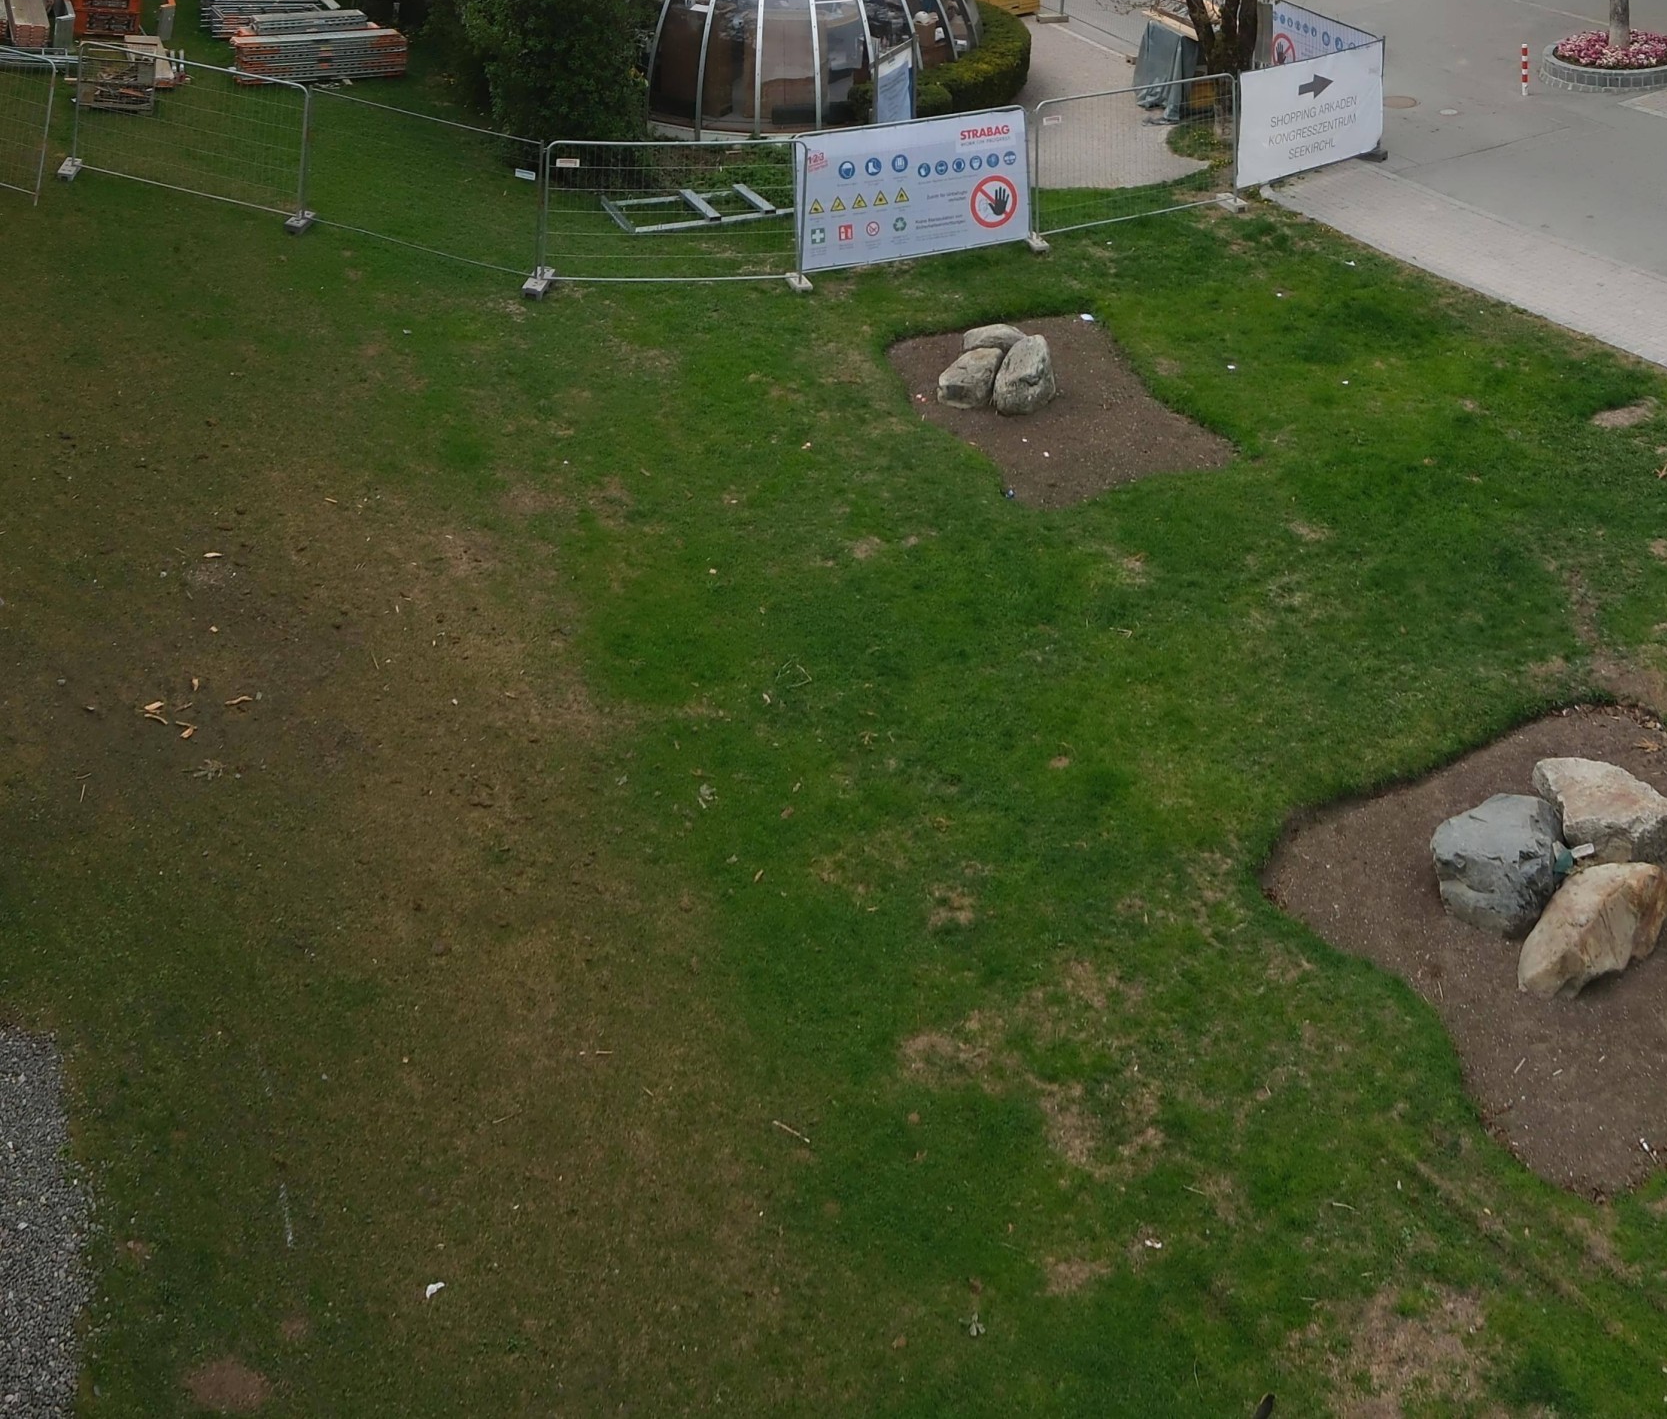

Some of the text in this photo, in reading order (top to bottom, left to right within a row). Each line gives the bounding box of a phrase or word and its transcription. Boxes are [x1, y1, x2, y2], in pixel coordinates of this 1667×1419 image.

[1270, 96, 1357, 128] SHOPPING ARKADEN
[960, 125, 1010, 140] STRABAG
[1268, 113, 1357, 146] KONGRESSZENTRUM
[1288, 138, 1336, 160] SEEKIRCHL
